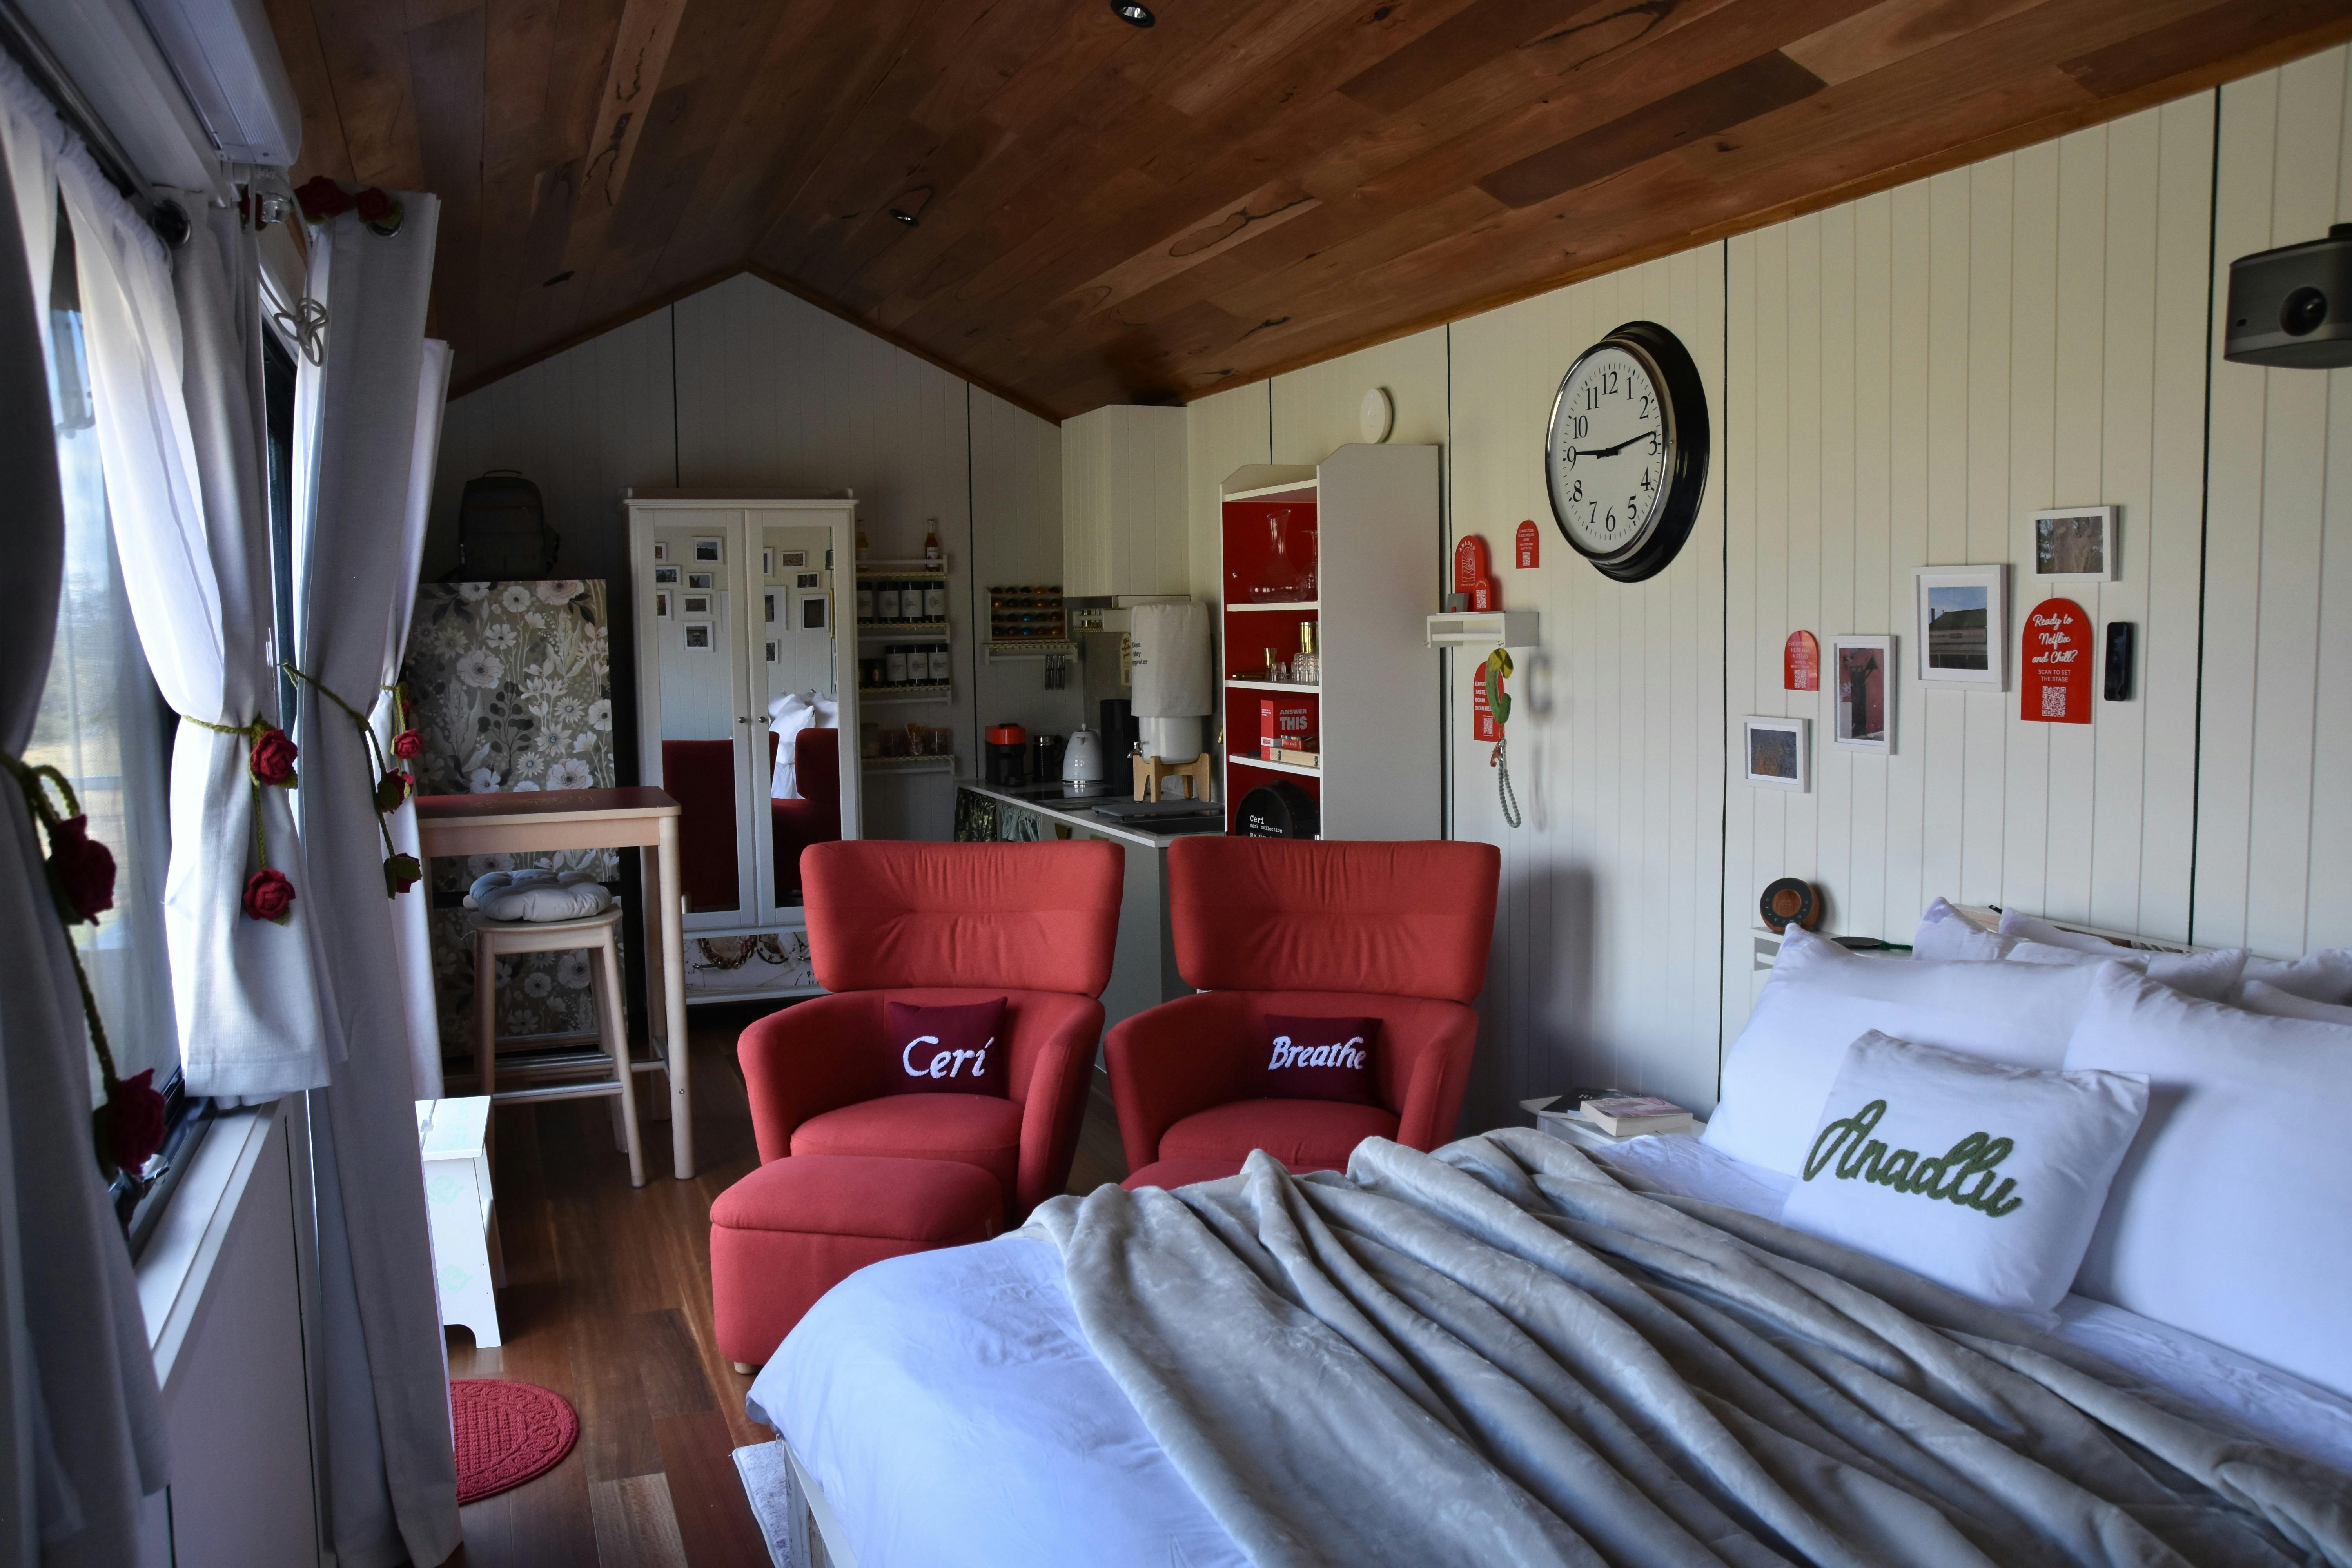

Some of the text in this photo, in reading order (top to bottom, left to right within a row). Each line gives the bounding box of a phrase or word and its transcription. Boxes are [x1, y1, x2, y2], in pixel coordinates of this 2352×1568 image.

[1602, 371, 1618, 395] 12
[1626, 376, 1632, 400] 1
[1585, 386, 1599, 410] 11
[1639, 396, 1649, 419] 2
[1572, 415, 1588, 439] 10
[1647, 431, 1657, 456] 3
[1567, 446, 1577, 471] 9
[1573, 479, 1583, 502] 8
[1640, 467, 1651, 491] 4
[1589, 501, 1598, 524] 7
[1605, 506, 1616, 532] 6
[1627, 495, 1637, 520] 5
[1459, 541, 1476, 552] ANADLU
[2033, 613, 2073, 630] Ready to
[2039, 632, 2071, 650] Netflix
[2032, 650, 2078, 664] and Chill?
[1279, 716, 1307, 730] THIS
[1250, 815, 1264, 824] Ceri
[903, 1036, 995, 1078] Ceri
[1268, 1036, 1366, 1070] Breathe
[1803, 1099, 2022, 1218] Anadlu
